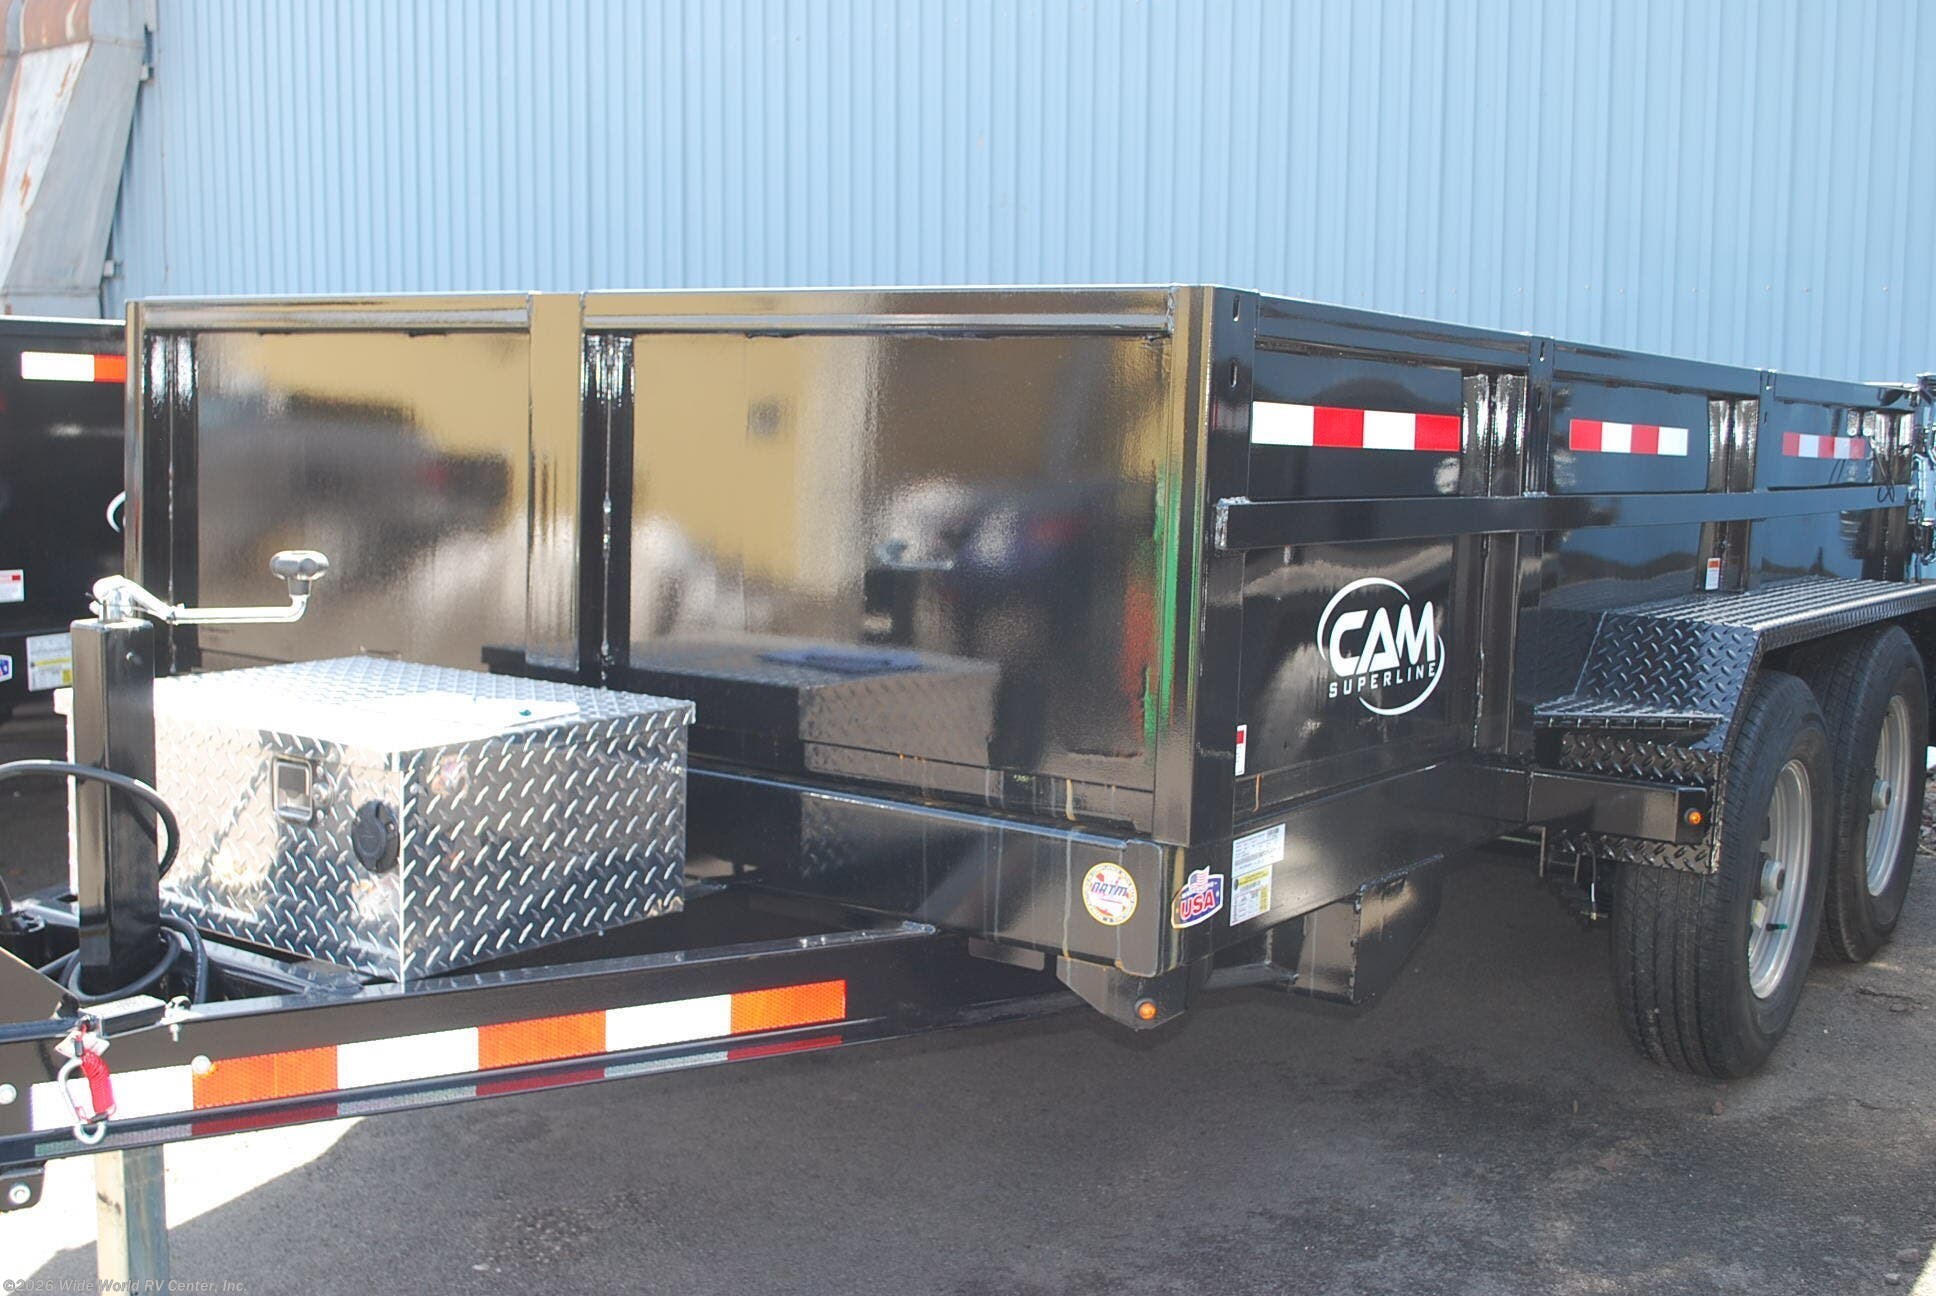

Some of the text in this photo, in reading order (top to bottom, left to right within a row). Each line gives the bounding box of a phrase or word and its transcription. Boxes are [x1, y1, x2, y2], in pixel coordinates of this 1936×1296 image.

[1329, 600, 1436, 677] CAM
[1328, 662, 1436, 698] SUPERLINE
[1180, 889, 1216, 920] USA
